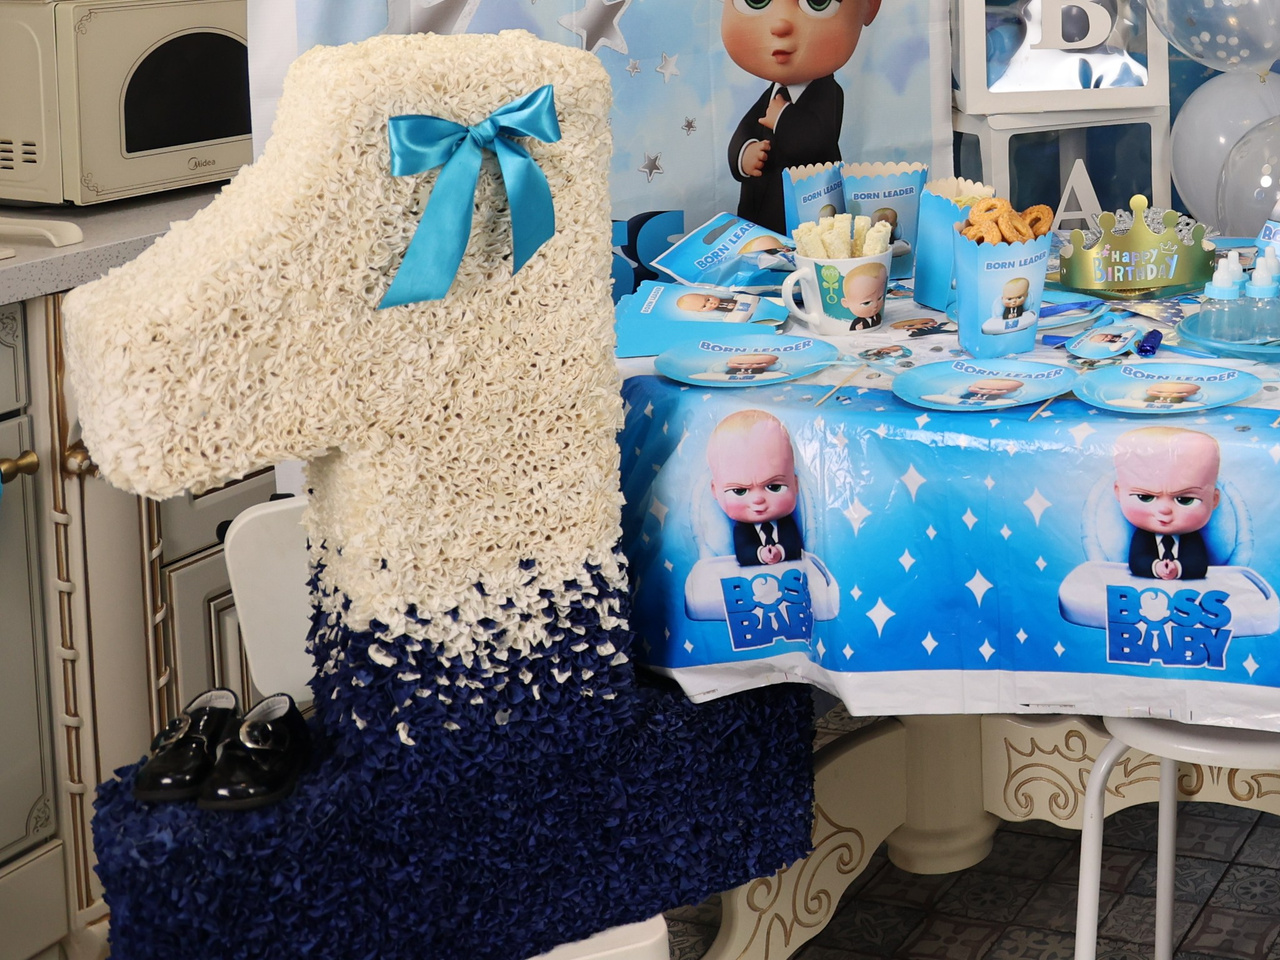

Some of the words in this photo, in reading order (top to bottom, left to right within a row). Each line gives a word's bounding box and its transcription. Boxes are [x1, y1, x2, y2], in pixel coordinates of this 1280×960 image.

[188, 156, 216, 171] Midea
[802, 190, 822, 203] BORN
[823, 180, 843, 195] LEADE
[853, 191, 880, 201] BORN
[883, 187, 915, 199] LEADER
[1051, 158, 1104, 233] A
[696, 243, 730, 269] BORN
[727, 222, 758, 245] LEAD
[986, 261, 1015, 270] BORN
[1018, 250, 1047, 267] LEADER
[700, 341, 747, 353] BORN
[752, 340, 813, 353] LEADER
[953, 361, 1000, 377] BORN
[1005, 368, 1063, 379] LEADER
[1122, 366, 1170, 380] BORN
[1176, 371, 1237, 382] LEADER
[1106, 585, 1232, 628] BOSS
[728, 604, 814, 650] BAB
[1108, 622, 1233, 668] BABY
